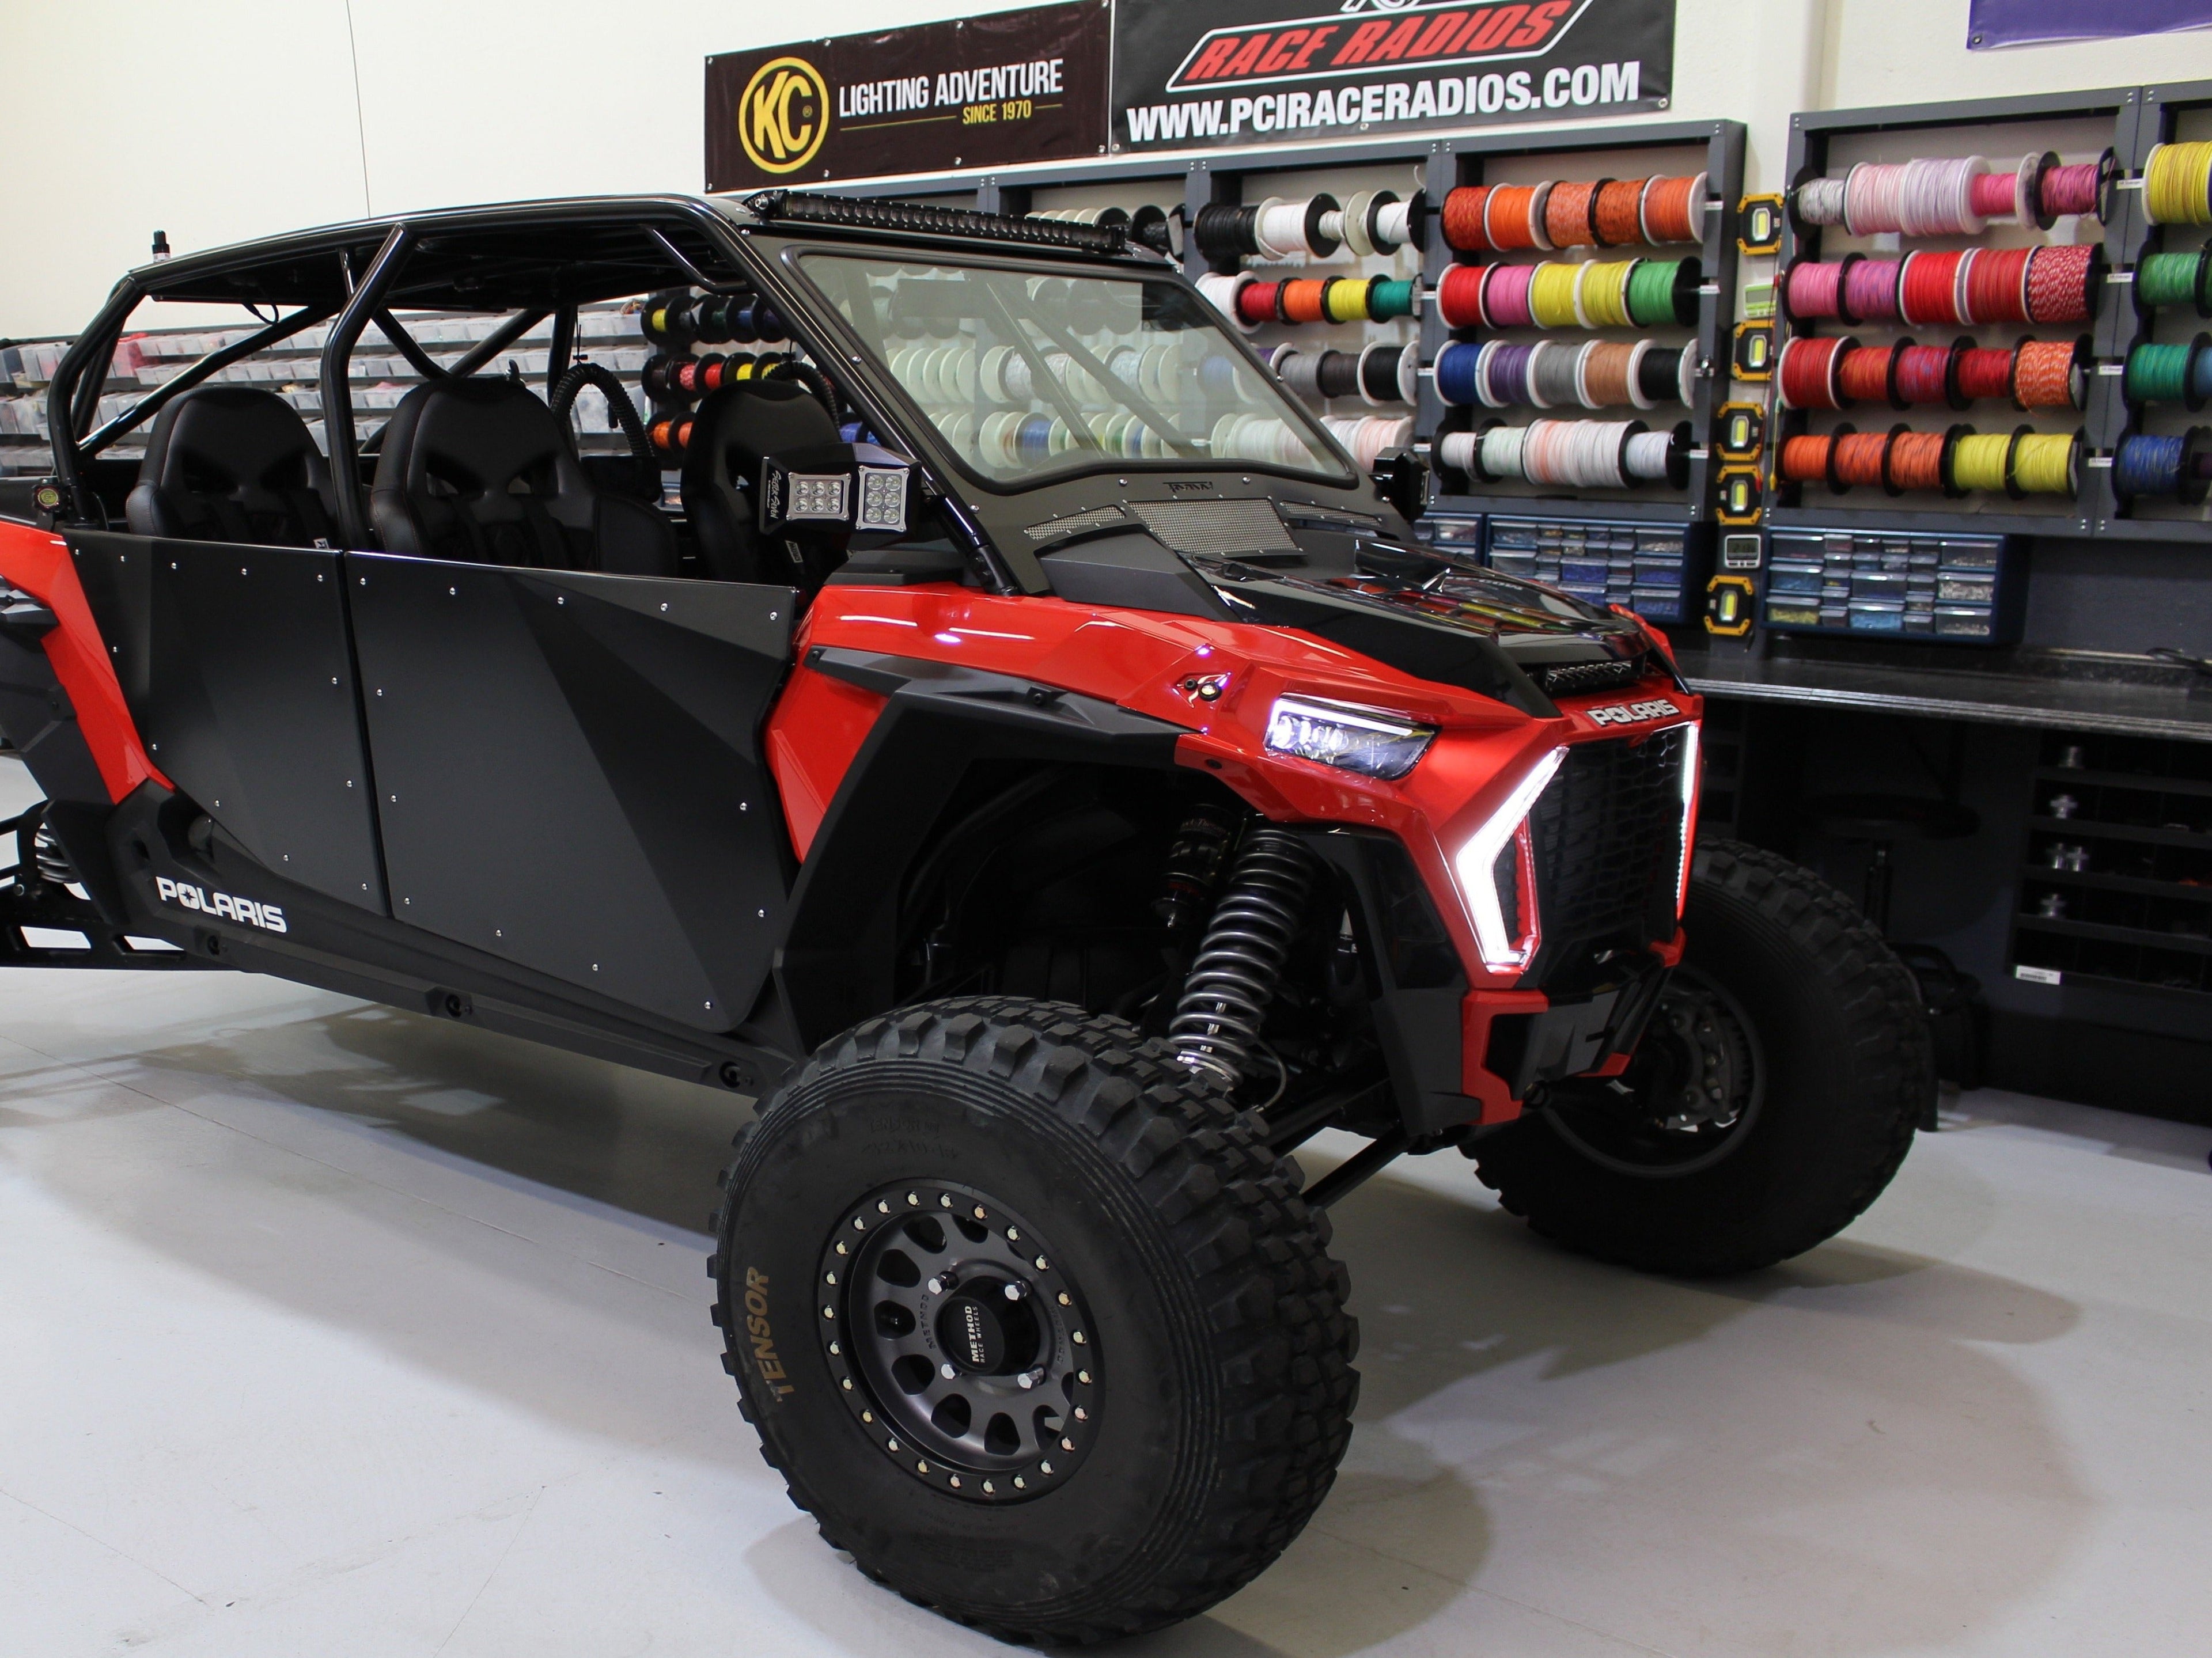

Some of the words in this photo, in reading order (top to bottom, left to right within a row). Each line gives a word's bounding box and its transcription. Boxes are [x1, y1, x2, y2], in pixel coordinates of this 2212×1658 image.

[1184, 26, 1339, 81] RACE
[1331, 0, 1573, 66] RADIOS
[753, 70, 813, 160] KC
[839, 75, 929, 118] LIGHTING
[934, 59, 1063, 106] ADVENTURE
[963, 104, 997, 126] SINCE
[1002, 100, 1032, 121] 1970
[1127, 62, 1641, 142] WWW.PCIRACERADIOS.COM
[1587, 699, 1680, 726] POLARIS
[155, 876, 287, 934] POLARIS
[744, 1266, 795, 1402] TENSOR
[964, 1305, 980, 1363] METHOD
[972, 1306, 982, 1339] WHEELS
[978, 1342, 986, 1363] RACE
